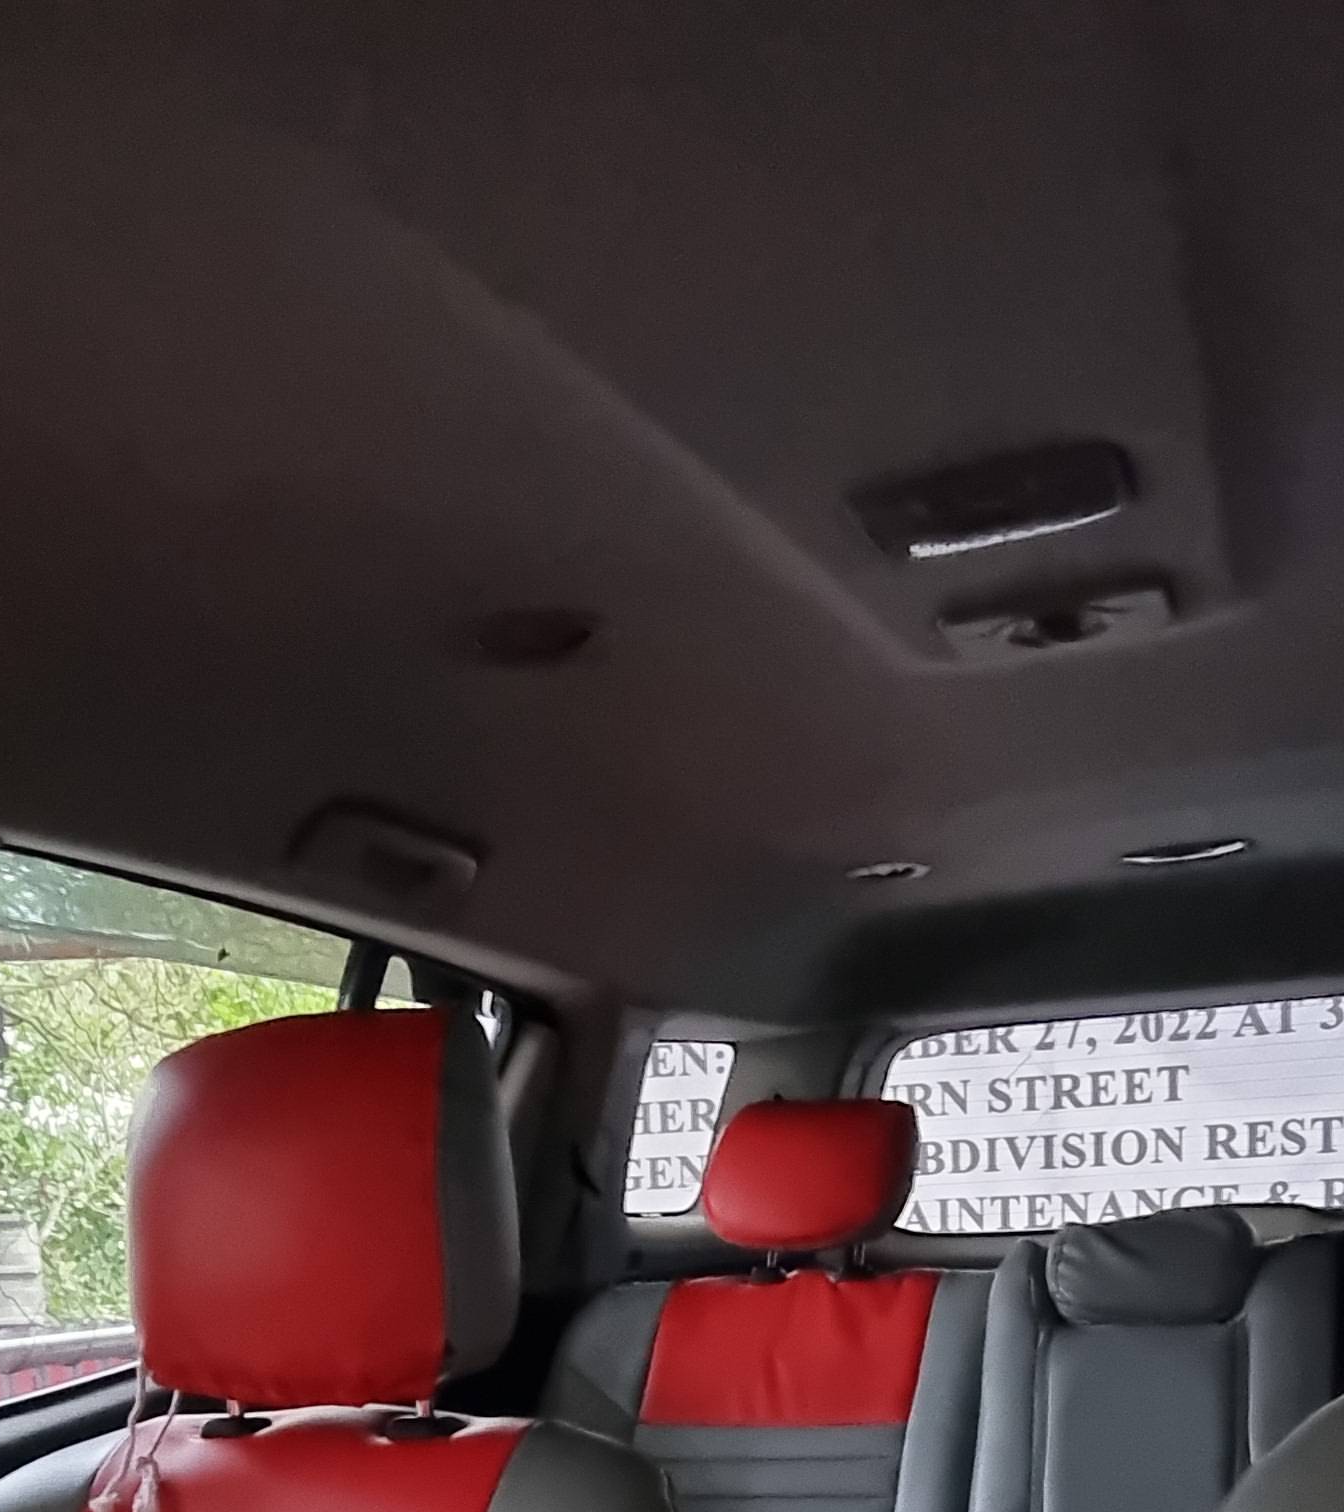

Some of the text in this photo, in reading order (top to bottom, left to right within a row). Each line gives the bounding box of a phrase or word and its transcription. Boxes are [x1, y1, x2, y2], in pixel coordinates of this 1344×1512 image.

[648, 1043, 724, 1078] EN:
[1114, 1009, 1218, 1045] 2022
[1233, 999, 1296, 1037] AT
[987, 1065, 1190, 1114] STREET
